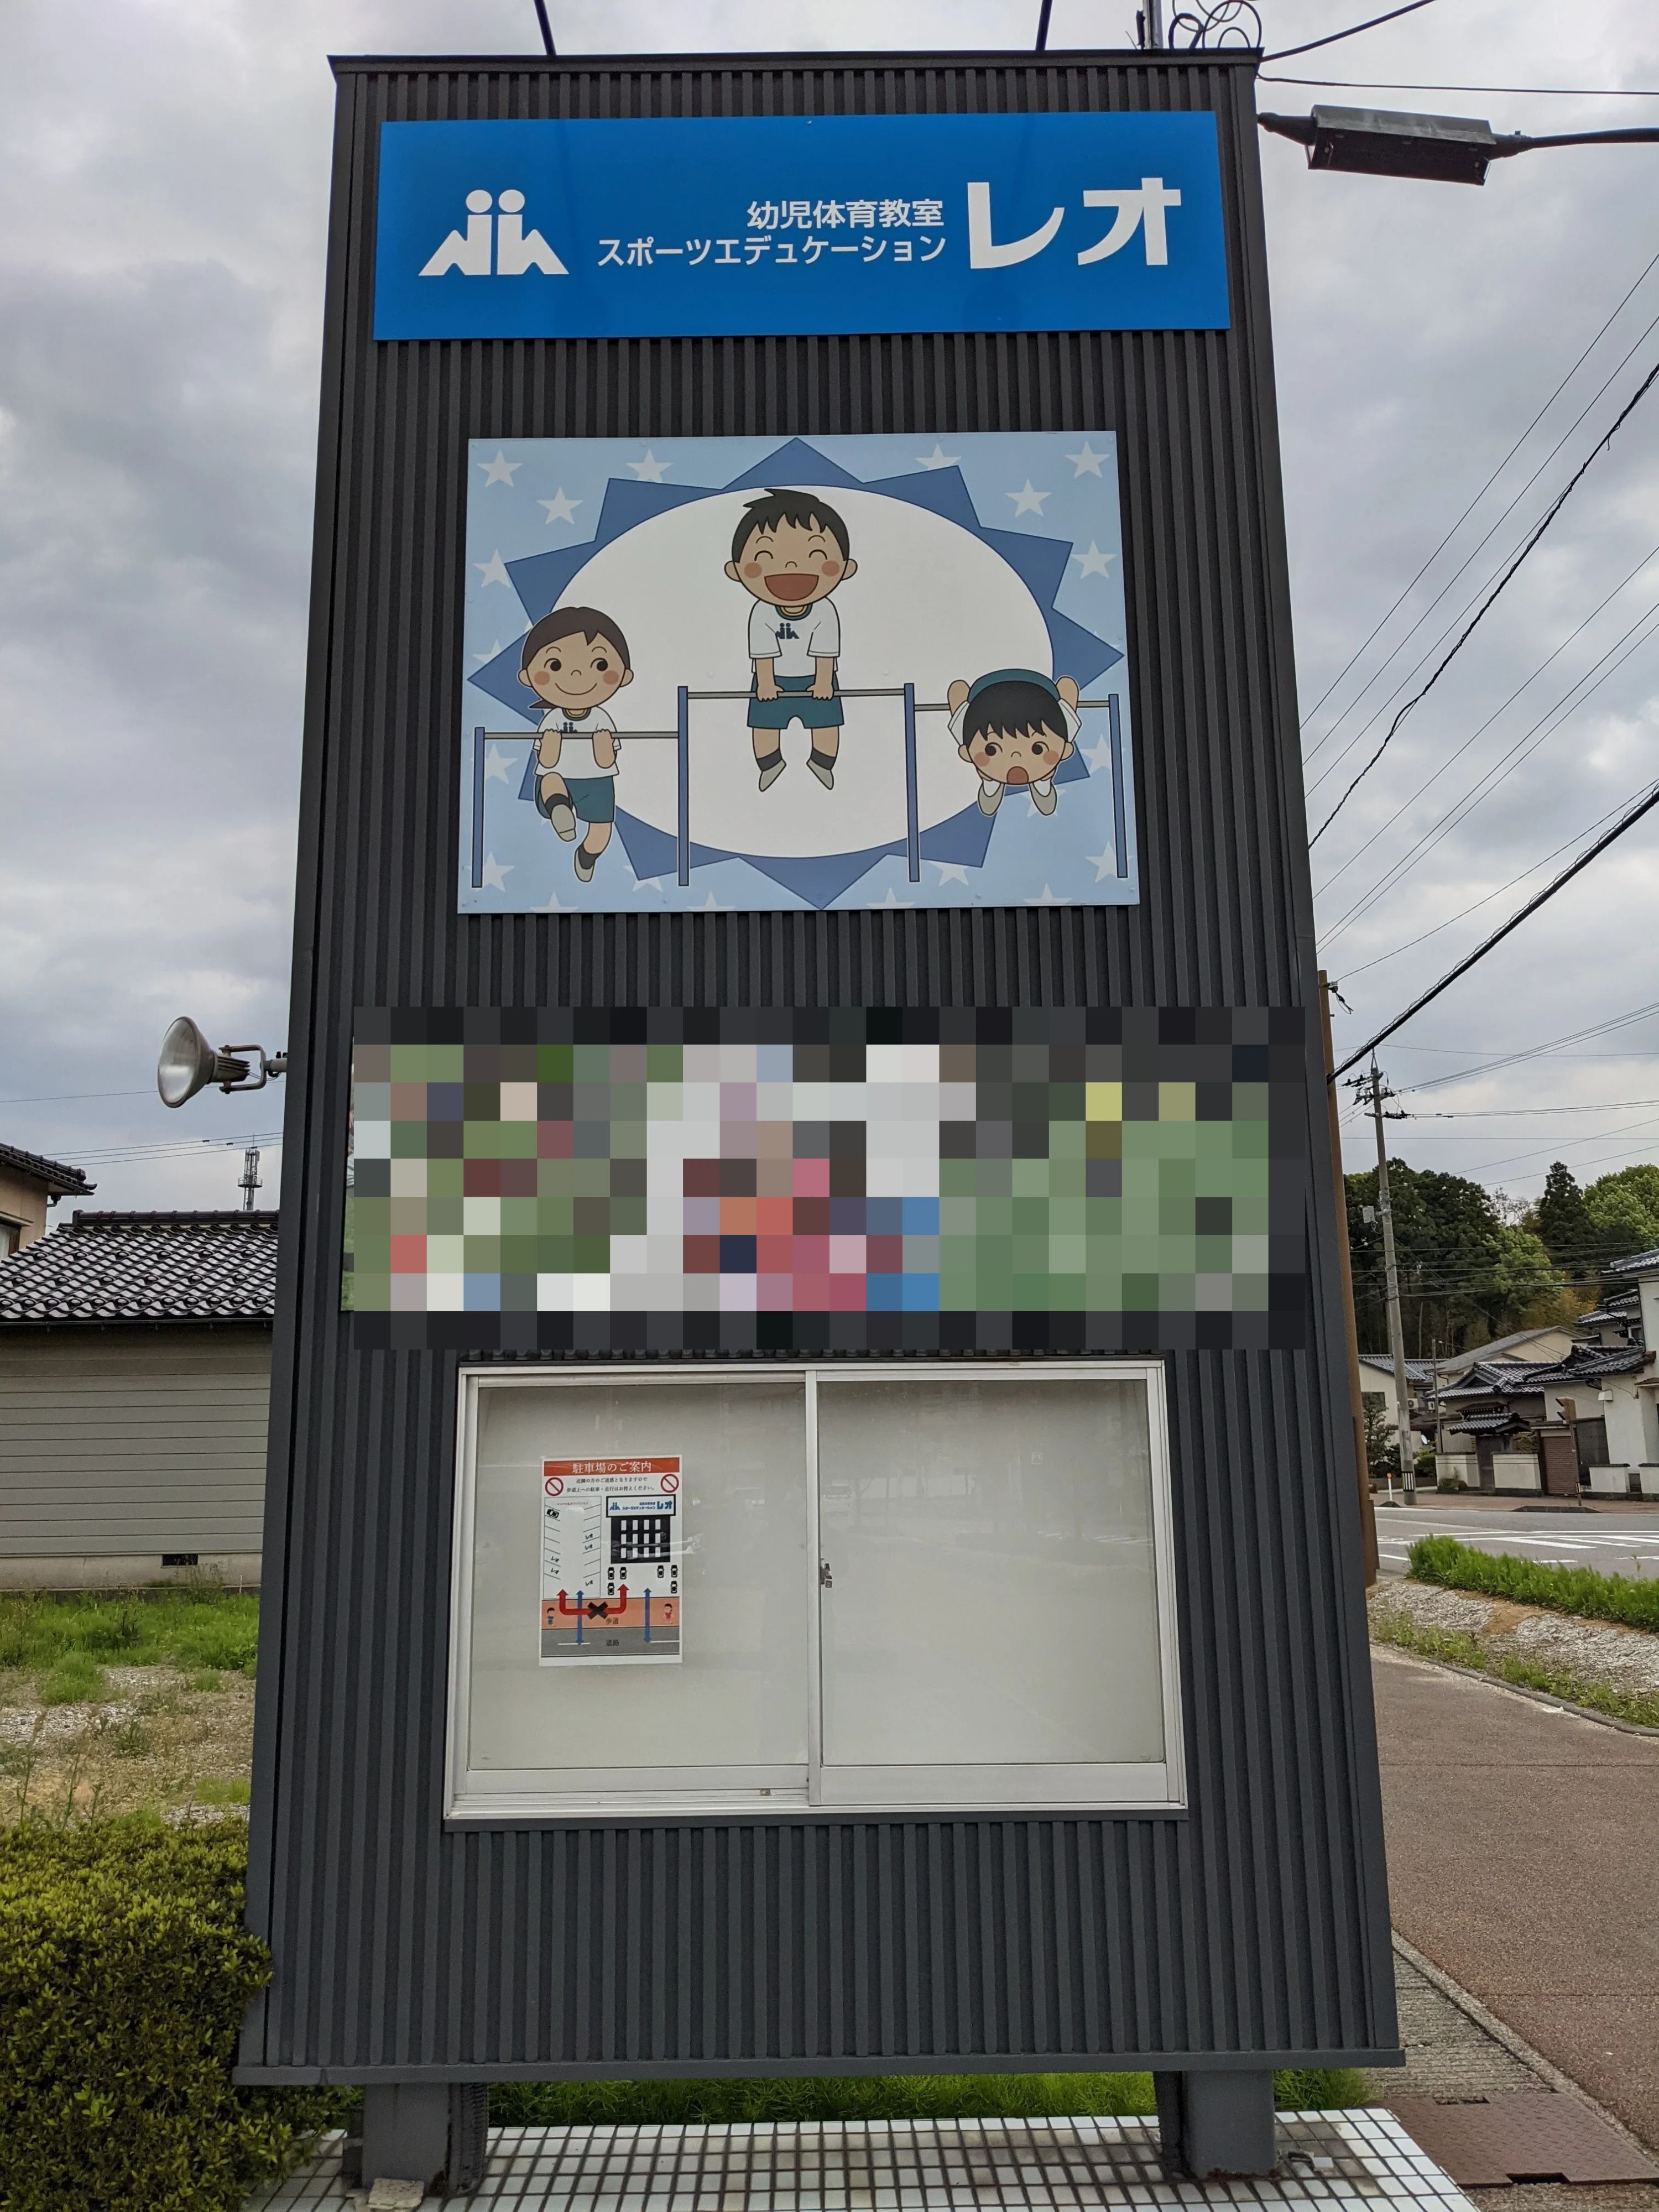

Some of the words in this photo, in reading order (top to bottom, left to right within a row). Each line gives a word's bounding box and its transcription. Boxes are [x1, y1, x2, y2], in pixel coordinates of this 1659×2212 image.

[748, 199, 943, 229] 幼児体育教室
[968, 178, 1181, 269] レオ
[598, 236, 945, 266] スポーツエデュケーション
[572, 1460, 651, 1474] 駐車場のご案内
[657, 1500, 672, 1510] レオ
